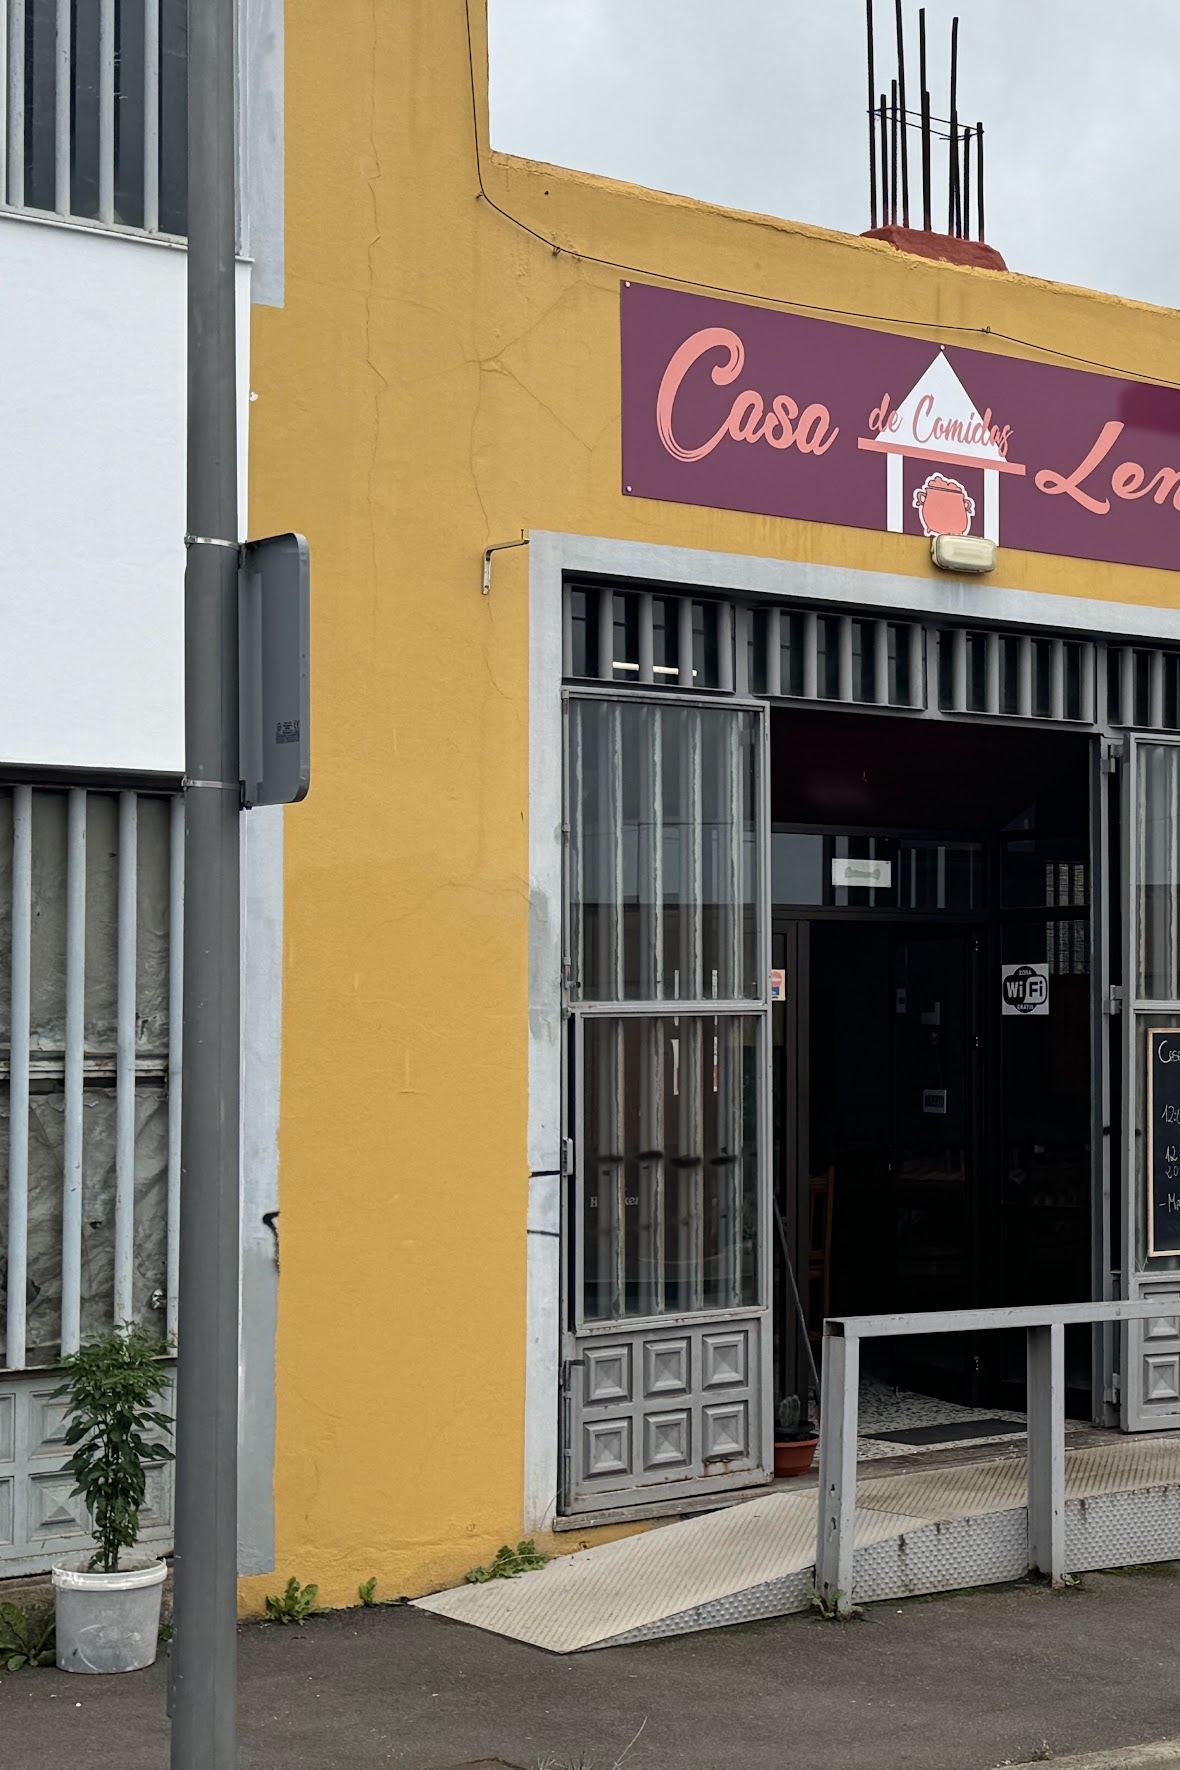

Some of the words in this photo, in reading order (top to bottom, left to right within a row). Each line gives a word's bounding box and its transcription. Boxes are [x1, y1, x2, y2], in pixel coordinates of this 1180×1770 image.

[657, 327, 840, 463] Casa
[868, 393, 903, 433] de
[912, 394, 1014, 458] Comidas
